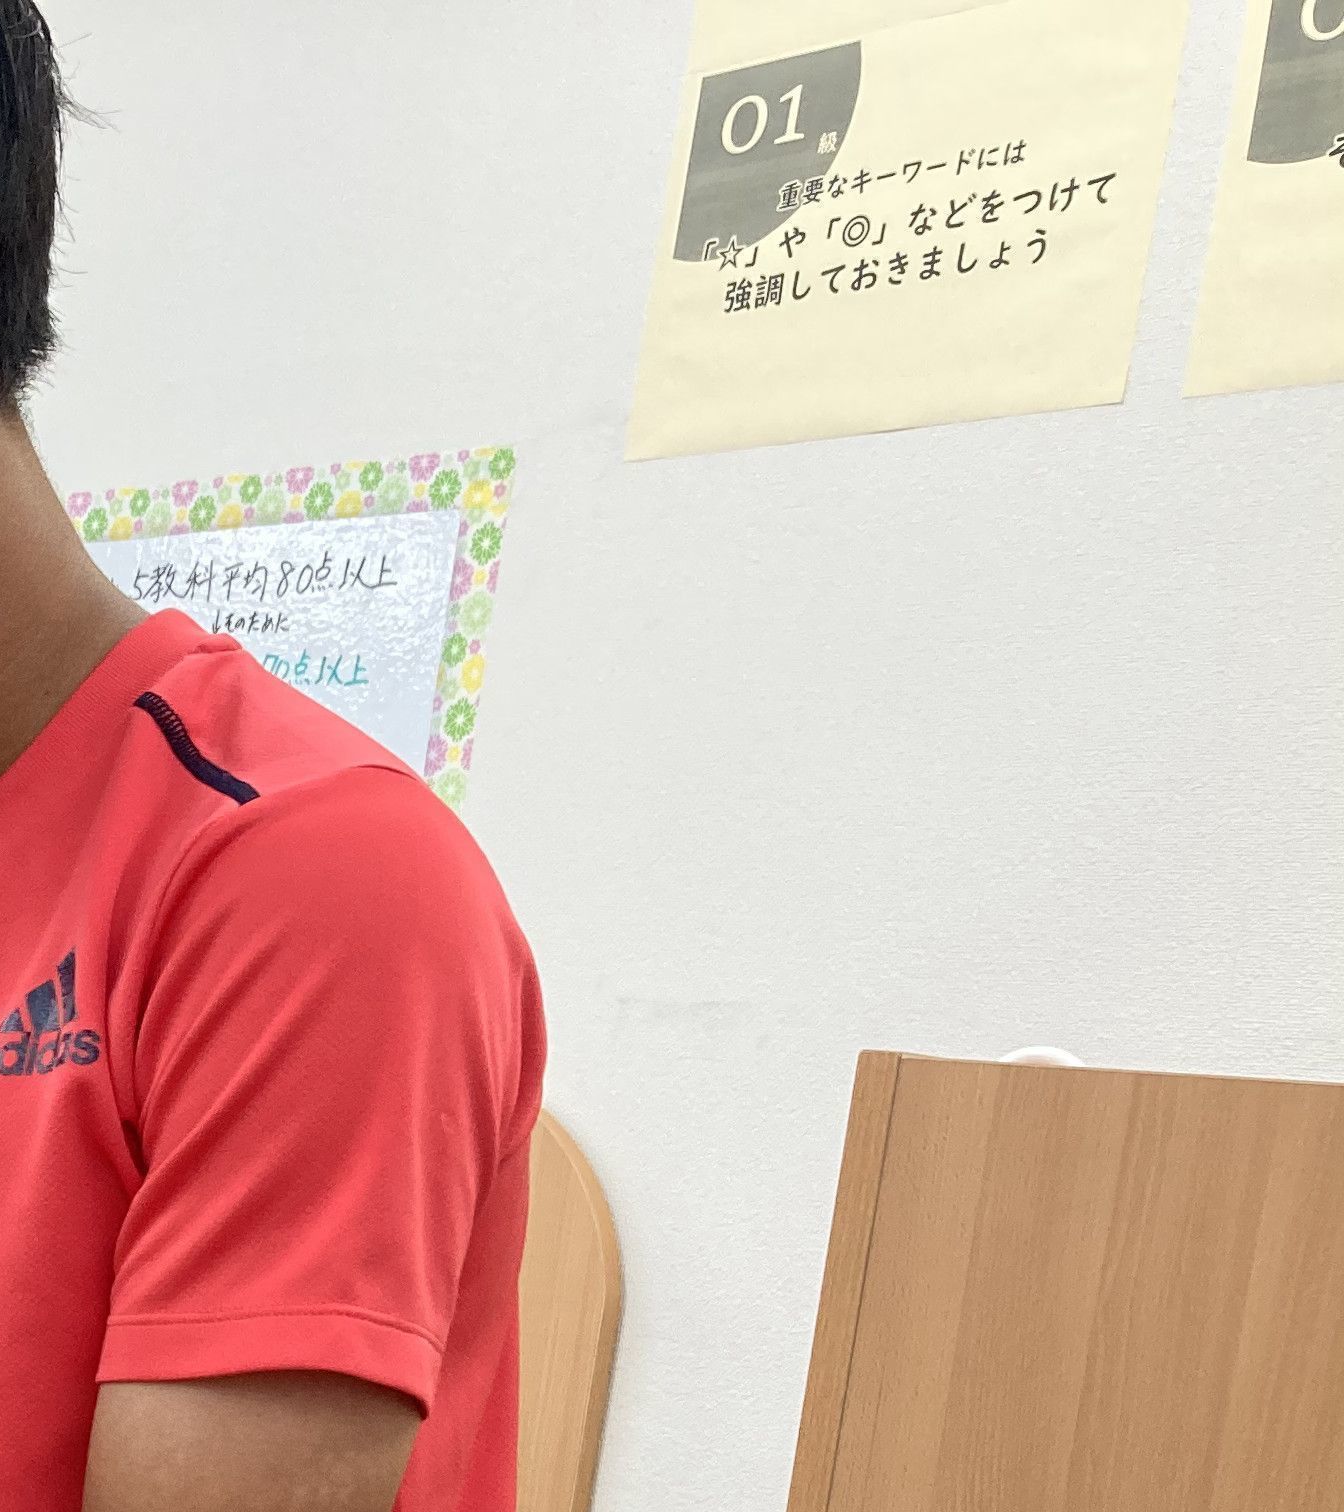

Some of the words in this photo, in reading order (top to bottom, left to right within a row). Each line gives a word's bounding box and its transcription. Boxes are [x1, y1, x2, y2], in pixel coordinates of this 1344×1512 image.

[720, 83, 806, 155] 01
[817, 131, 838, 154] 級
[777, 139, 1027, 212] 重要なキーワードには
[723, 228, 1049, 313] 強調しておきましょう
